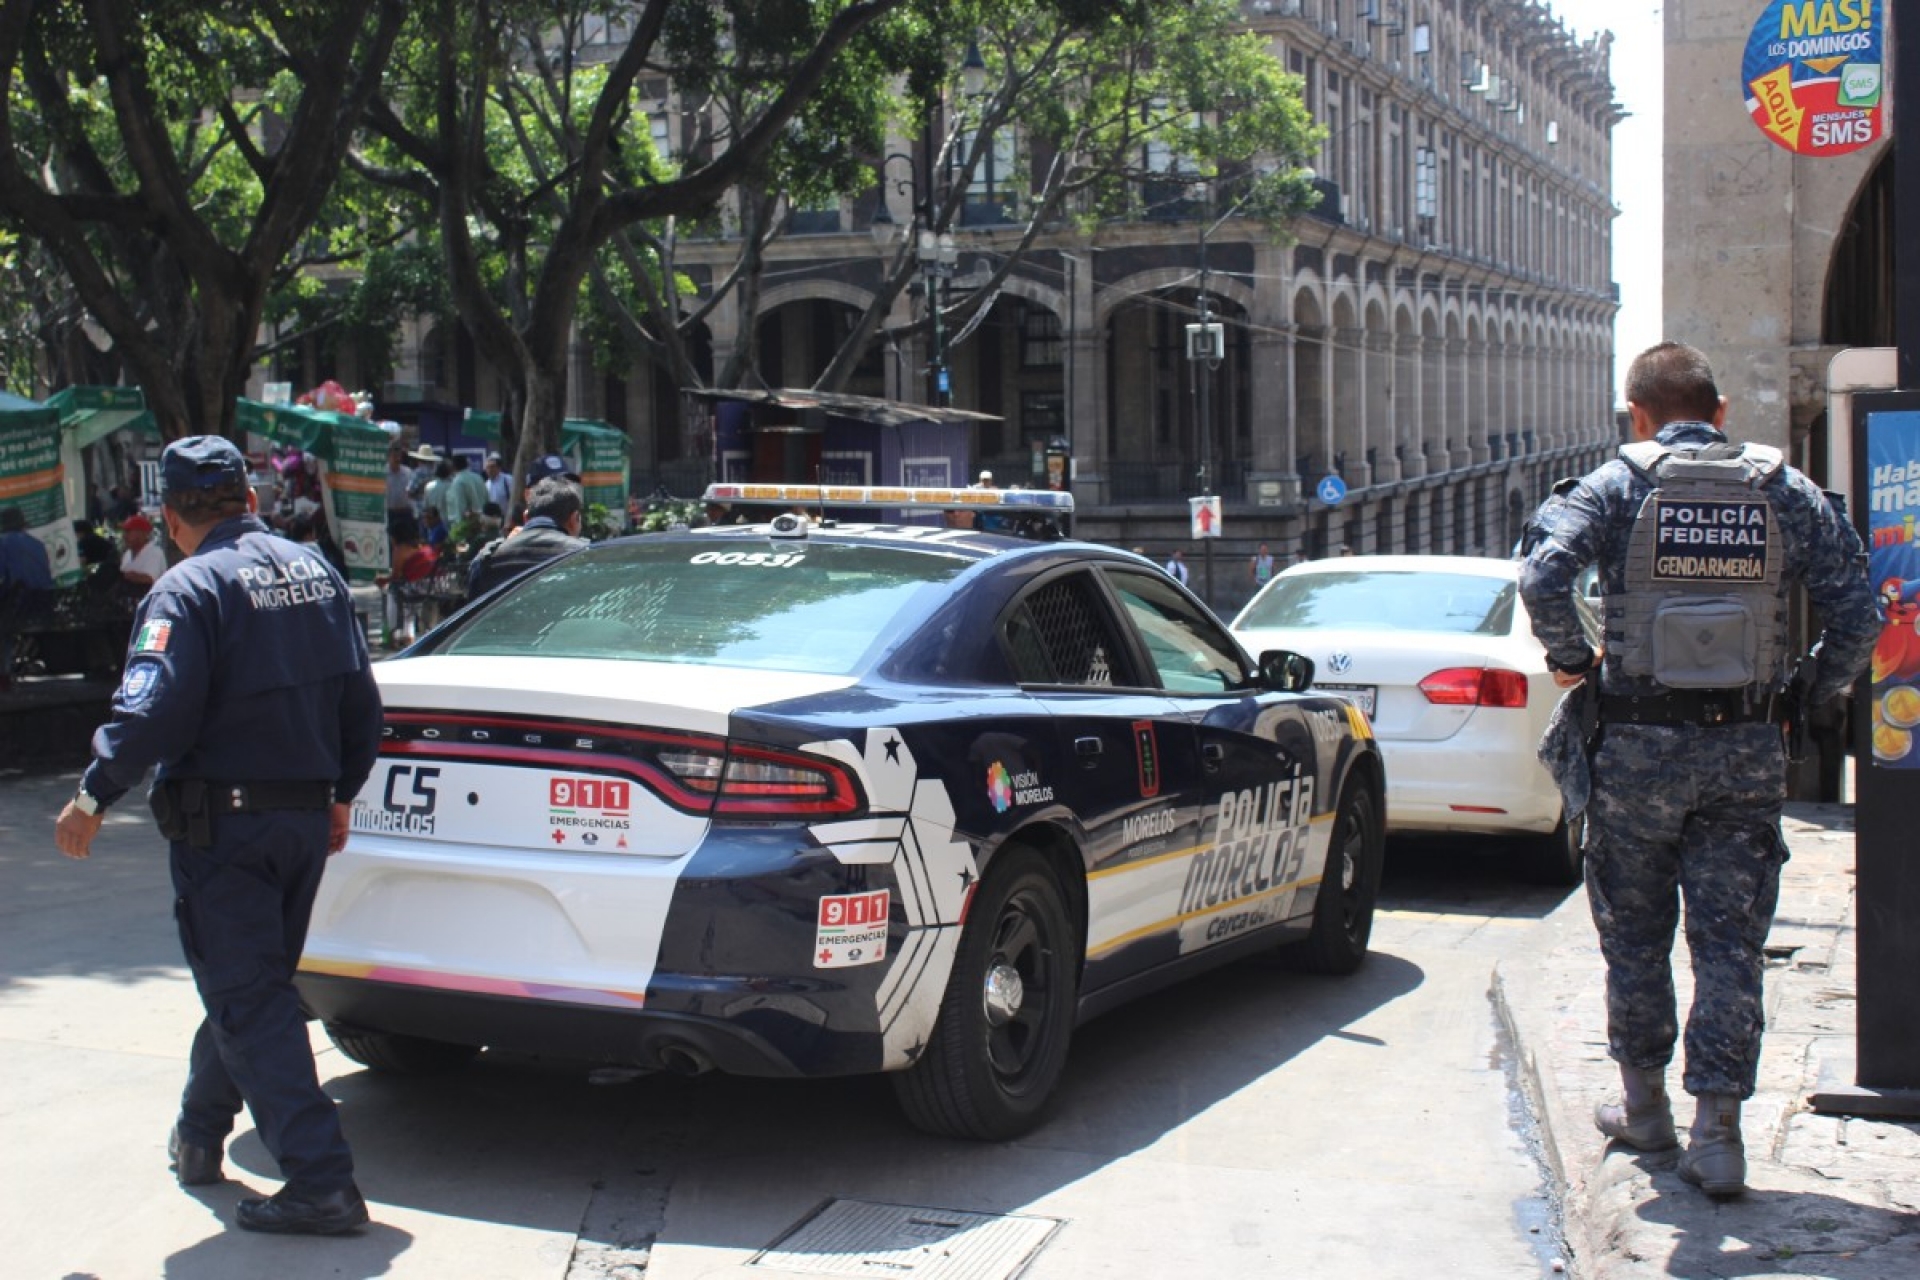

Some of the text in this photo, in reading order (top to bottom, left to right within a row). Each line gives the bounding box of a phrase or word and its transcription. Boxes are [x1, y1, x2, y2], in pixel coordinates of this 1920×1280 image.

[1780, 0, 1872, 39] MÁS!
[1768, 32, 1871, 58] LOS DOMINGOS
[1849, 77, 1874, 90] SMS
[1812, 111, 1865, 123] MENSAJES
[1811, 119, 1872, 147] SMS
[1660, 505, 1764, 526] POLICÍA
[1660, 527, 1765, 545] FEDERAL
[237, 557, 329, 588] POLICÍA
[1657, 553, 1762, 577] GENDARMERÍA
[250, 580, 337, 609] MORELOS
[383, 764, 440, 815] C5
[554, 782, 621, 808] 911
[1015, 786, 1054, 806] MORELOS
[549, 815, 630, 830] EMERGENCIAS
[1122, 808, 1176, 845] MORELOS
[827, 897, 883, 924] 911
[818, 929, 886, 945] EMERGENCIAS
